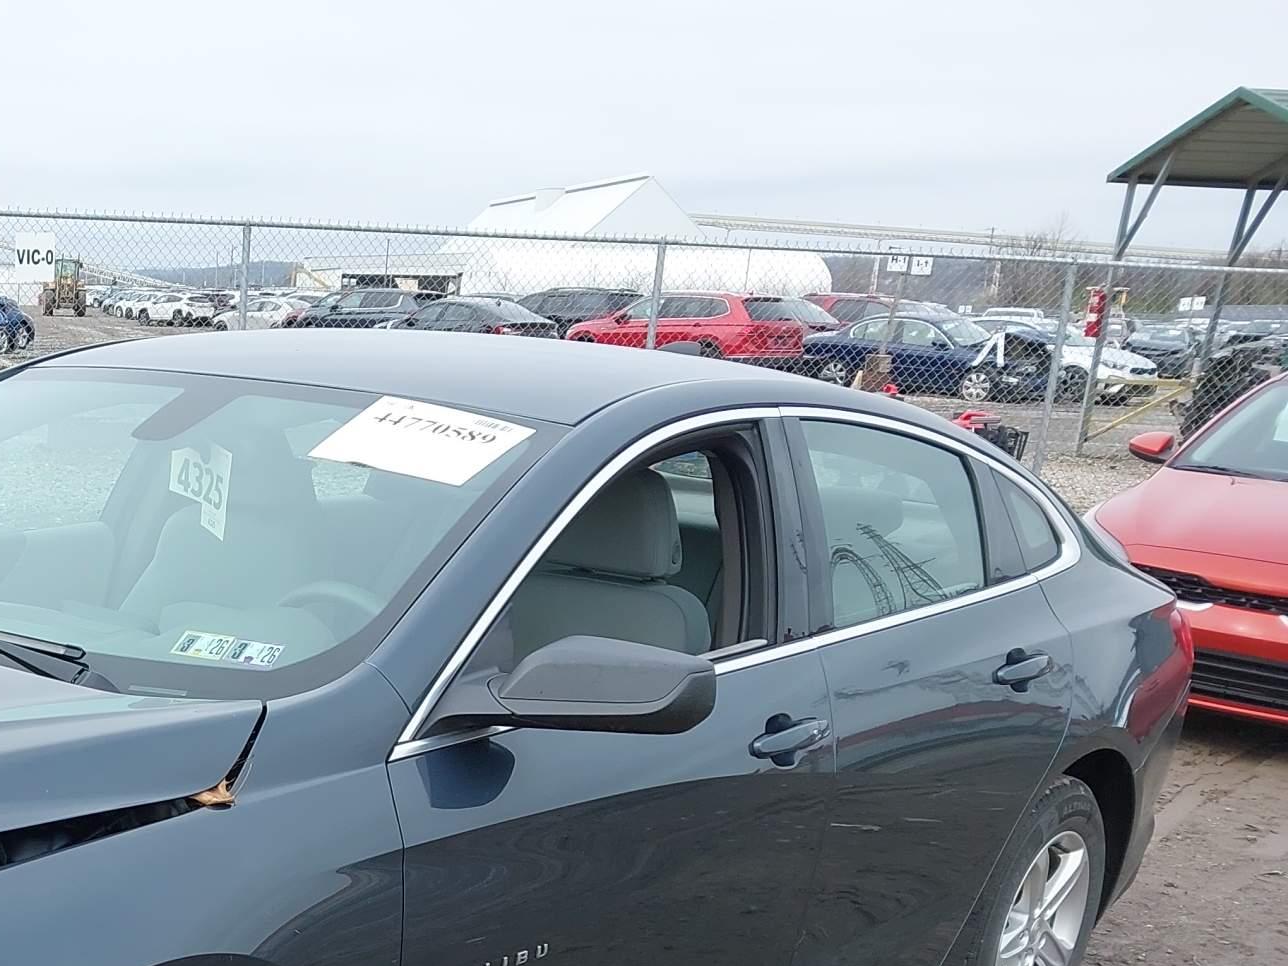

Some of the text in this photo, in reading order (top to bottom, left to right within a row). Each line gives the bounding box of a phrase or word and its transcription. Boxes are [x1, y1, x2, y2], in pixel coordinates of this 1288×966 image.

[890, 255, 907, 264] H-1
[373, 411, 497, 445] 44770589
[177, 457, 224, 511] 4325
[180, 638, 195, 653] 3
[231, 642, 248, 660] 3
